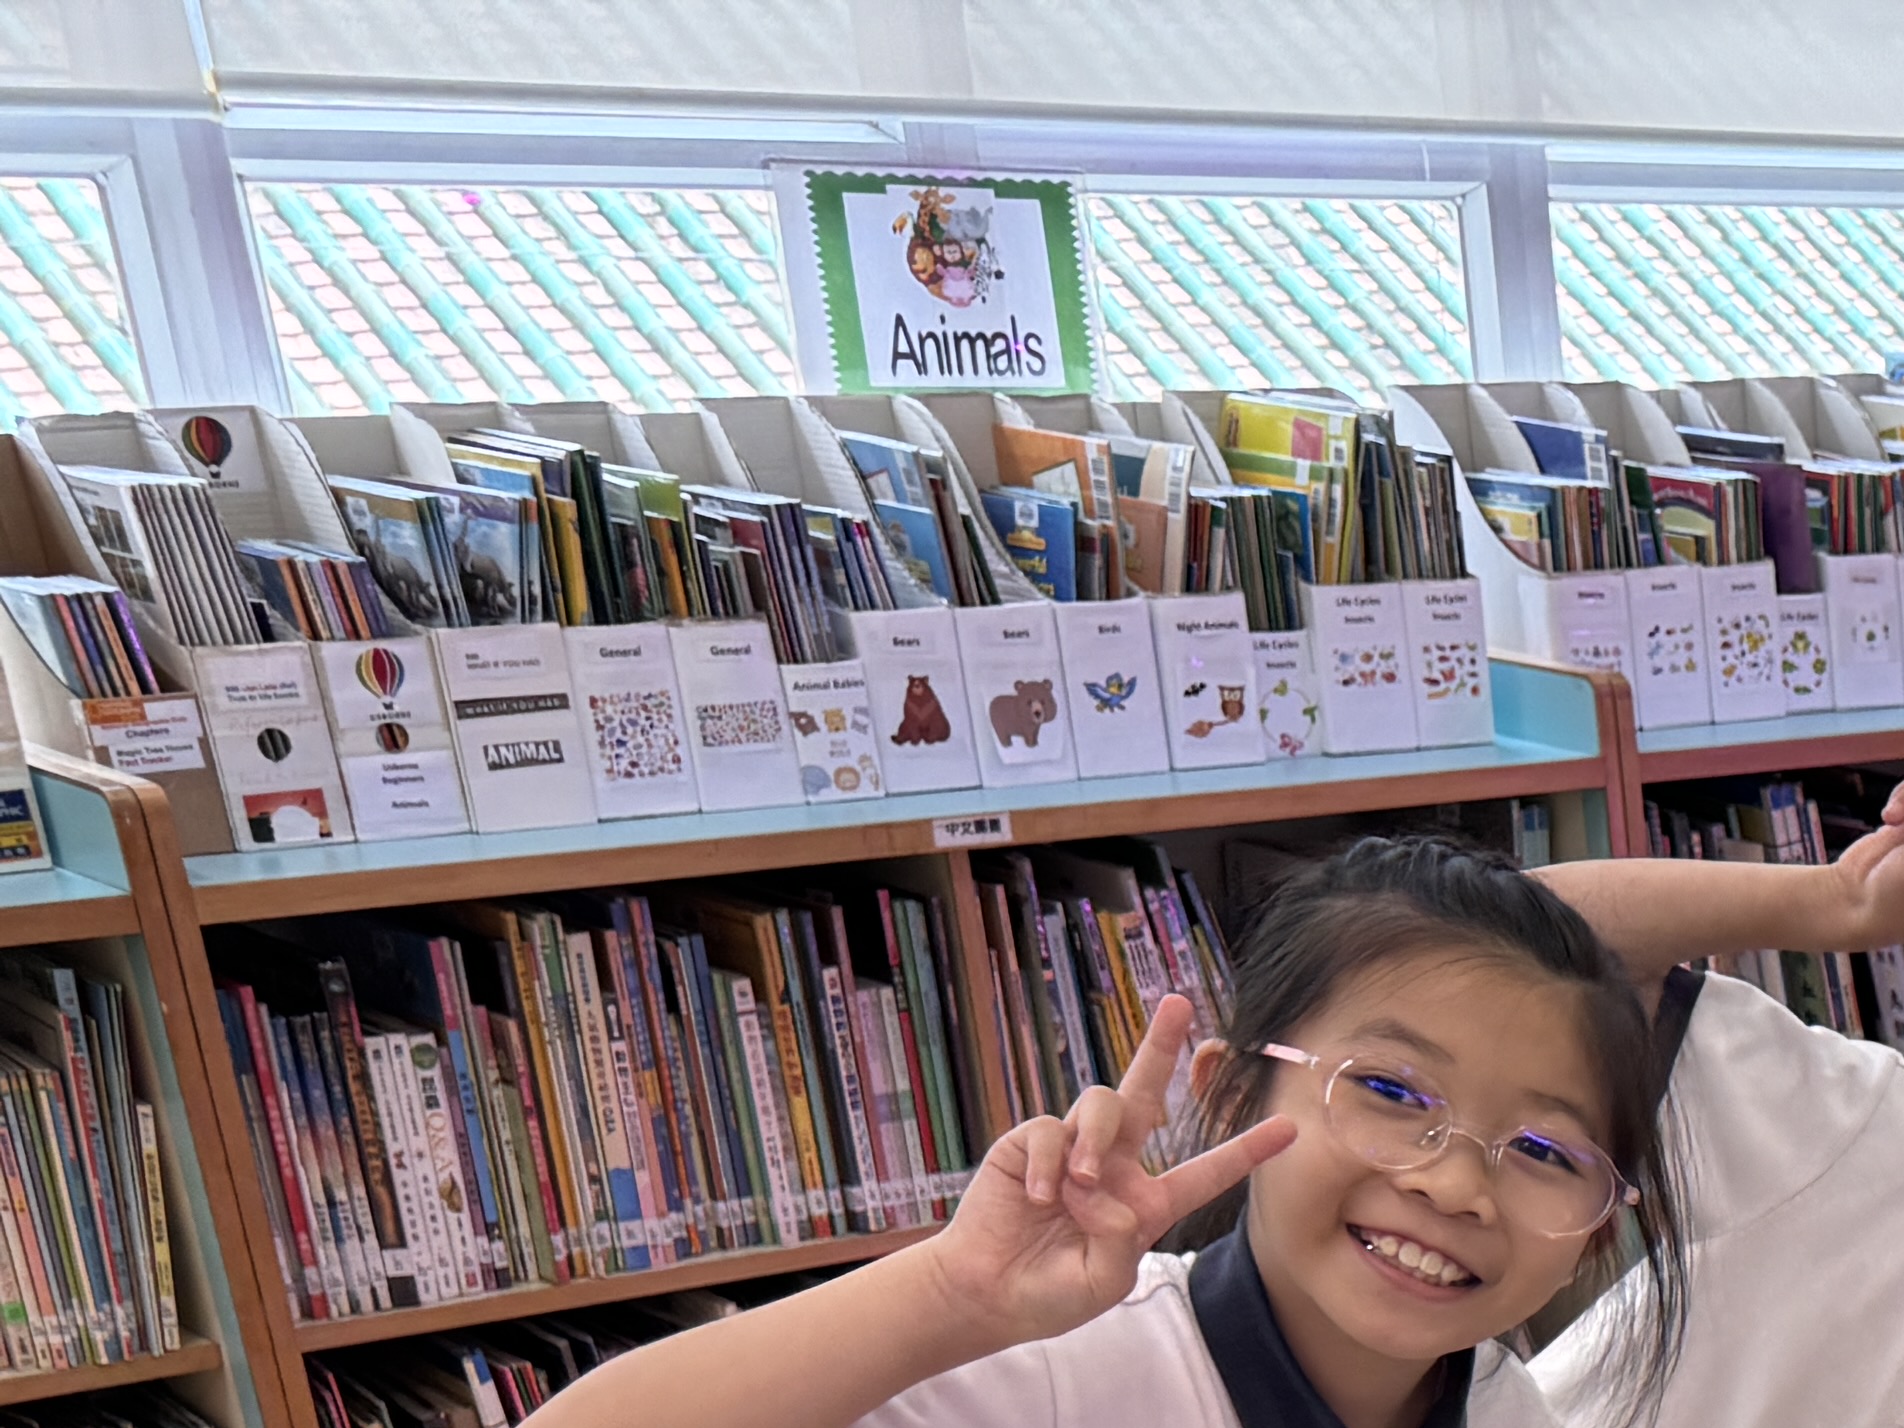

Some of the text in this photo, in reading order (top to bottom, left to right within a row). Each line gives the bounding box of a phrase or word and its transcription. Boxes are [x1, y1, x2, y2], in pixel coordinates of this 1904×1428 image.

[891, 313, 1046, 377] Animals
[1097, 623, 1121, 635] Birds
[1177, 619, 1240, 635] Night Animals
[892, 635, 921, 647] Bears
[1003, 628, 1030, 641] Bears
[599, 645, 642, 659] General
[710, 644, 752, 658] General
[1253, 639, 1272, 651] Life
[793, 676, 865, 692] Animal Babies
[125, 726, 170, 739] Chapters
[487, 741, 562, 766] ANIMAL
